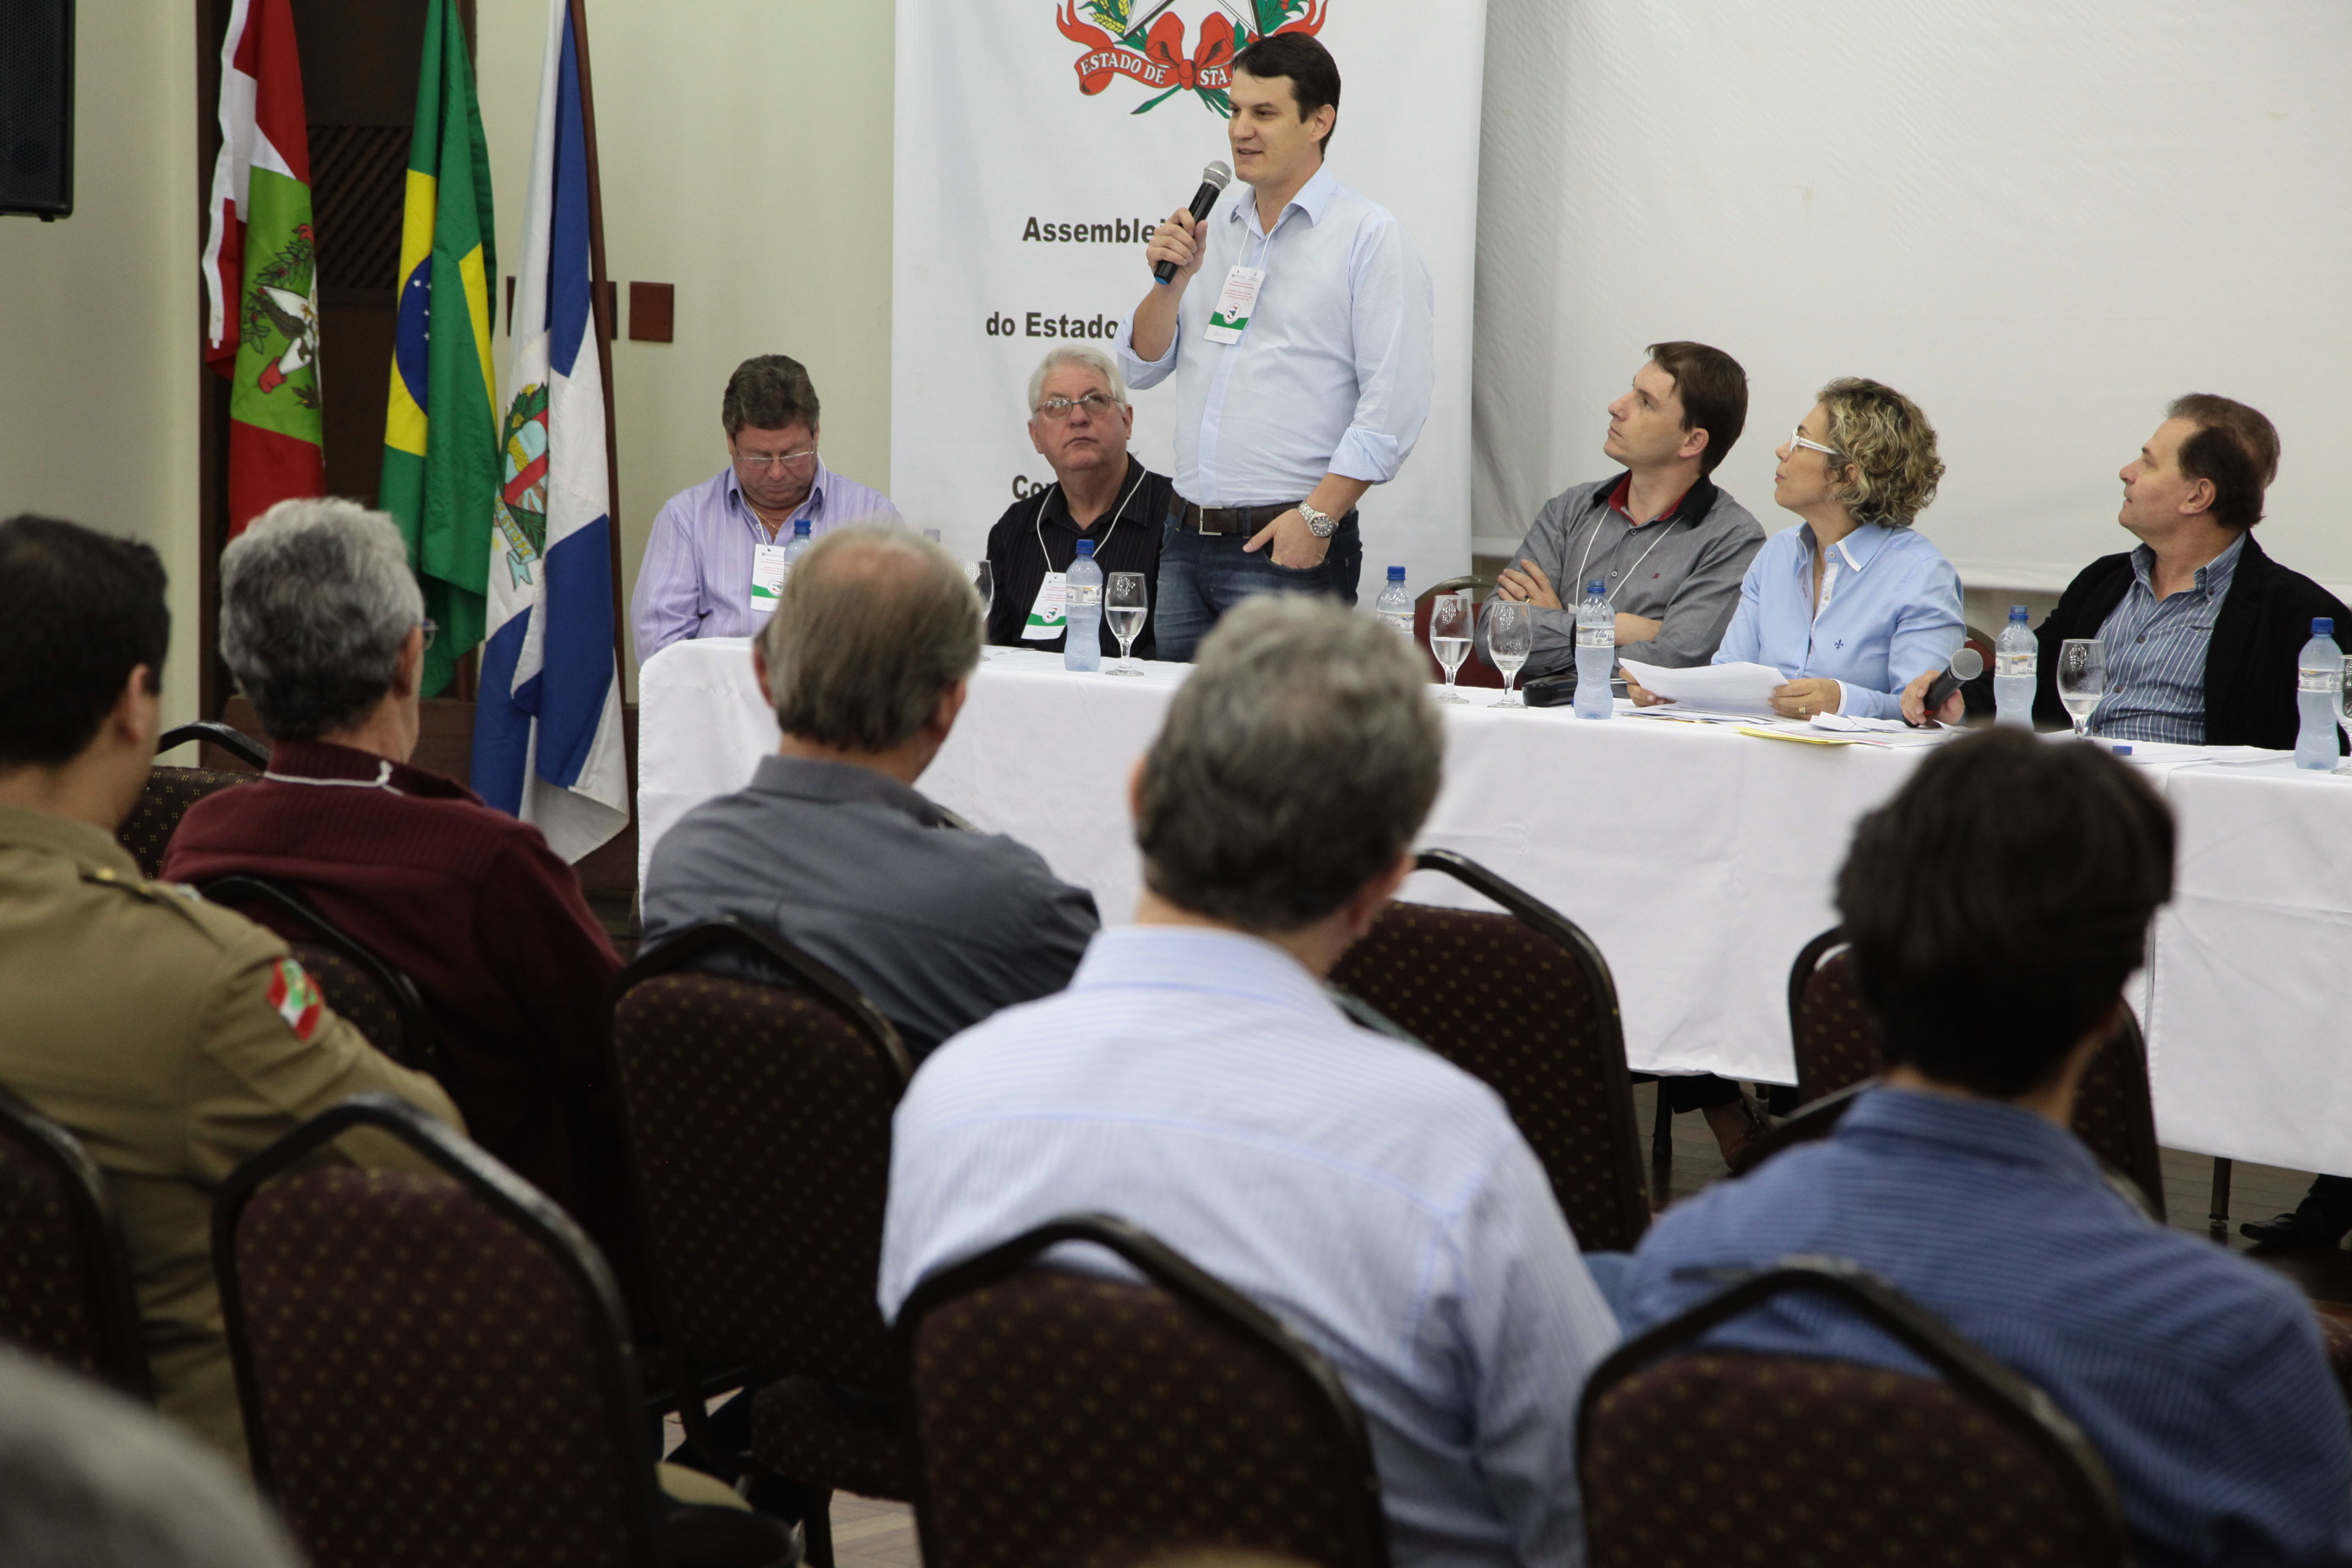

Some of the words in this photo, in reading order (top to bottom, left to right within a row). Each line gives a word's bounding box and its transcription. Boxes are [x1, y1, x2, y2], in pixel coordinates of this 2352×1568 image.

[1080, 52, 1141, 76] ESTADO
[1143, 64, 1166, 84] DE
[1021, 216, 1166, 243] Assemble
[986, 311, 1015, 336] do
[1026, 312, 1119, 339] Estado
